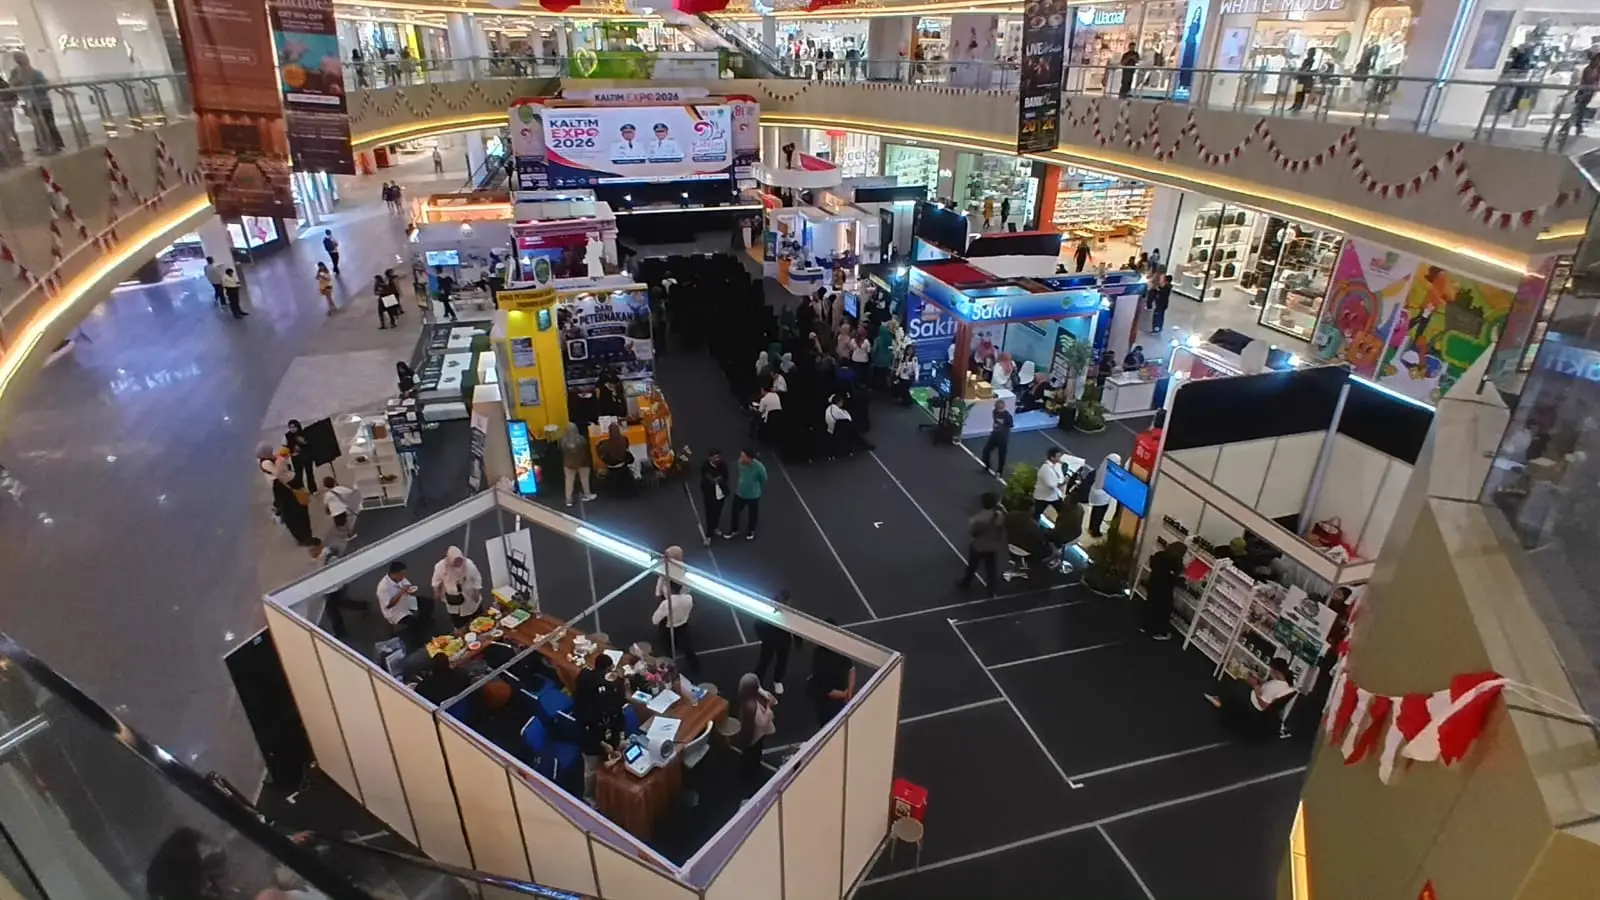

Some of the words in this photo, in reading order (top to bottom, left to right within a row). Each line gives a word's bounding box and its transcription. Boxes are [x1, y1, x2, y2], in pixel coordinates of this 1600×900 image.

[1220, 0, 1272, 14] WHITE
[1094, 9, 1125, 25] Wacoal
[594, 93, 624, 102] KALTIM
[627, 92, 654, 102] EXPO
[655, 92, 679, 101] 2026
[551, 127, 599, 138] EXPO
[553, 138, 596, 148] 2026
[594, 304, 613, 313] DARI
[971, 301, 1012, 320] Sakti
[579, 311, 633, 325] PETERNAKAN
[909, 316, 958, 338] Sakti
